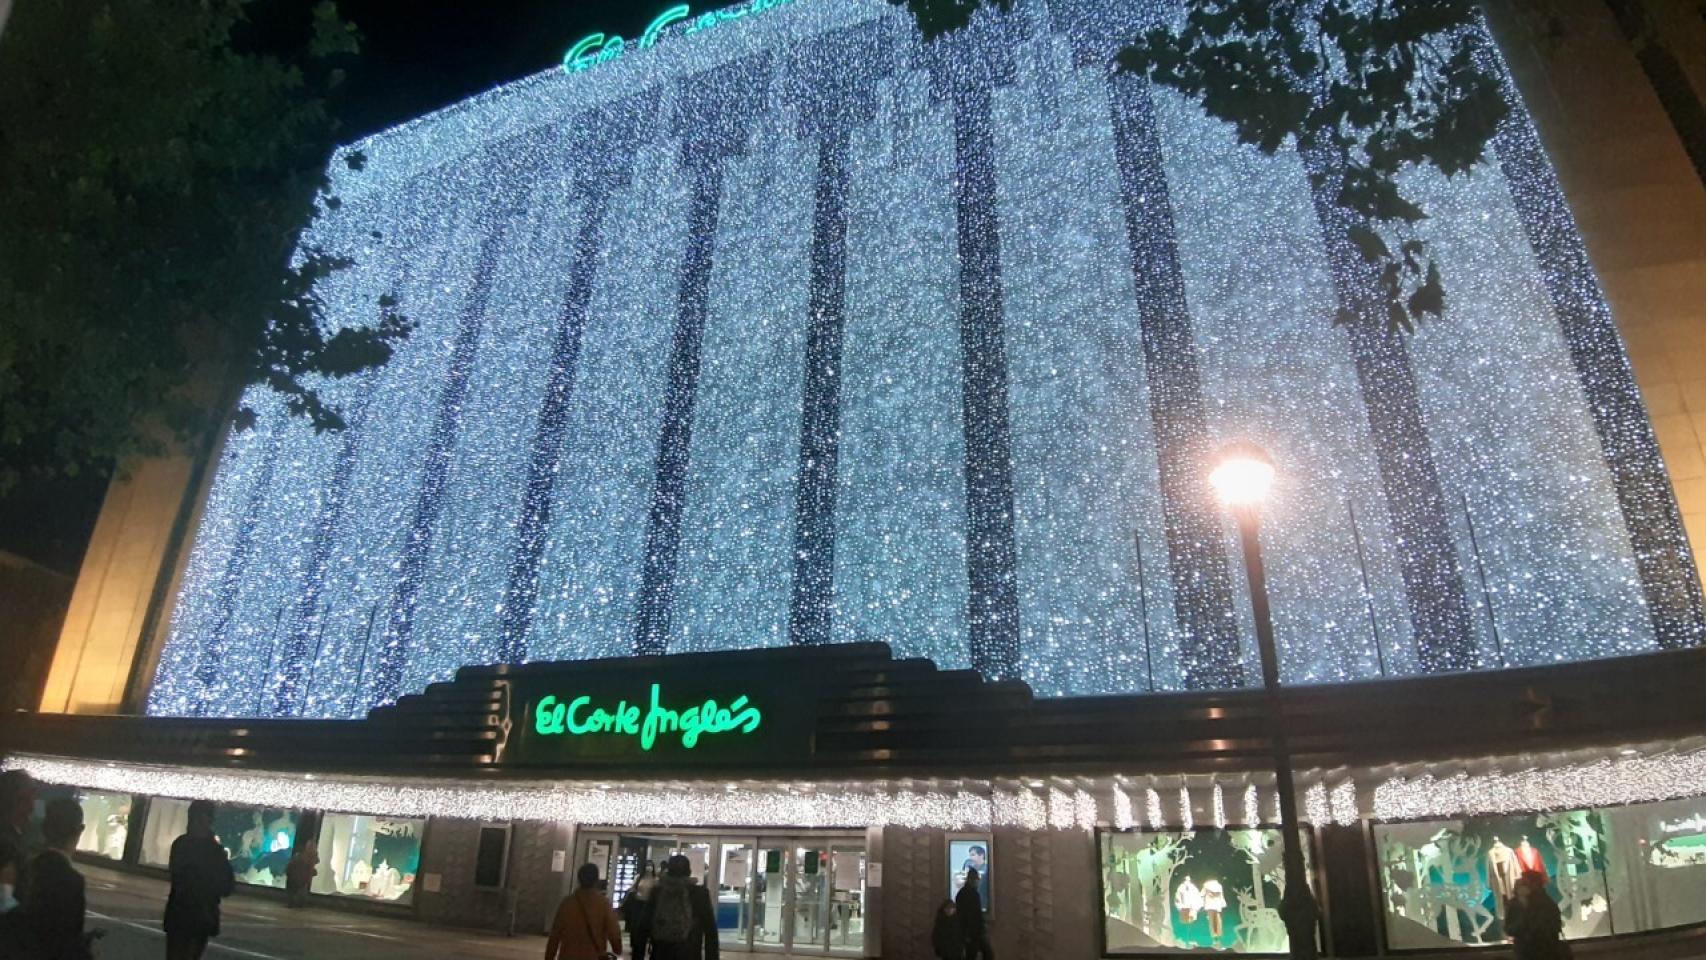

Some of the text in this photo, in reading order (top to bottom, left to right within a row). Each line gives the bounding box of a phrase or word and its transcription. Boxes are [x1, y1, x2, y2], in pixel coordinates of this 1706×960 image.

[536, 683, 761, 750] El Corte Inglés
